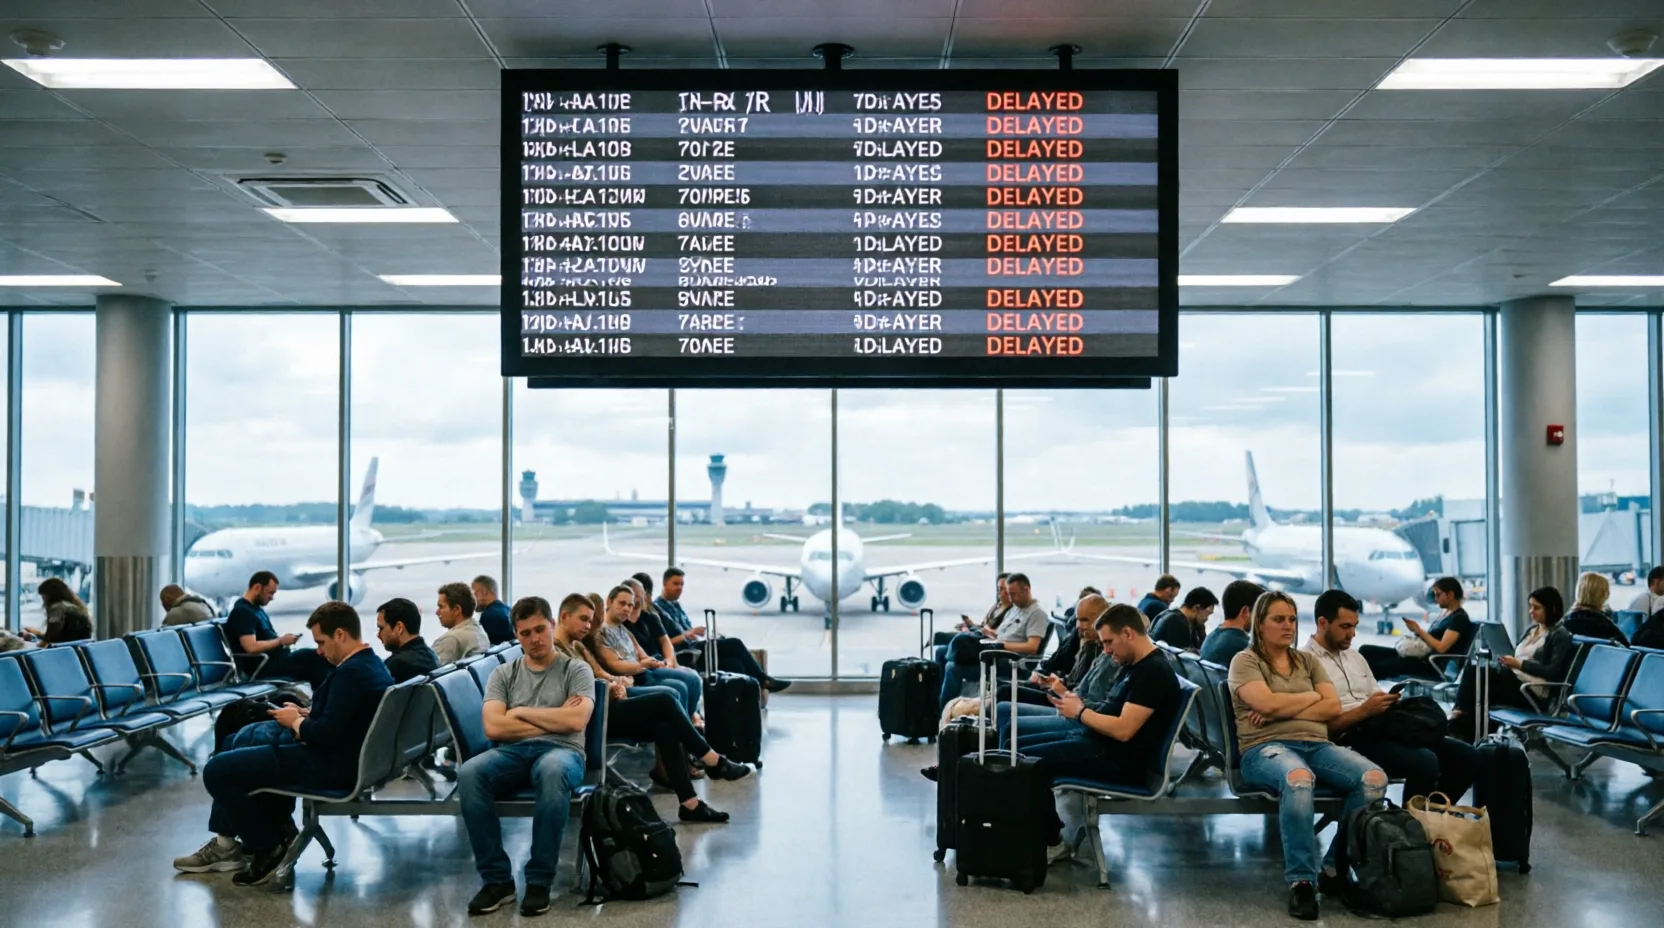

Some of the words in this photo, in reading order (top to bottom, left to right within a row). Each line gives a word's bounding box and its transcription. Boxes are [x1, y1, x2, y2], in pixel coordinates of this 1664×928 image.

[987, 92, 1084, 111] DELAYED
[987, 116, 1084, 134] DELAYED
[987, 140, 1084, 158] DELAYED
[987, 164, 1084, 181] DELAYED
[987, 187, 1084, 205] DELAYED
[987, 211, 1084, 229] DELAYED
[987, 234, 1084, 252] DELAYED
[987, 257, 1084, 274] DELAYED
[987, 289, 1084, 308] DELAYED
[987, 313, 1084, 332] DELAYED
[987, 337, 1084, 355] DELAYED
